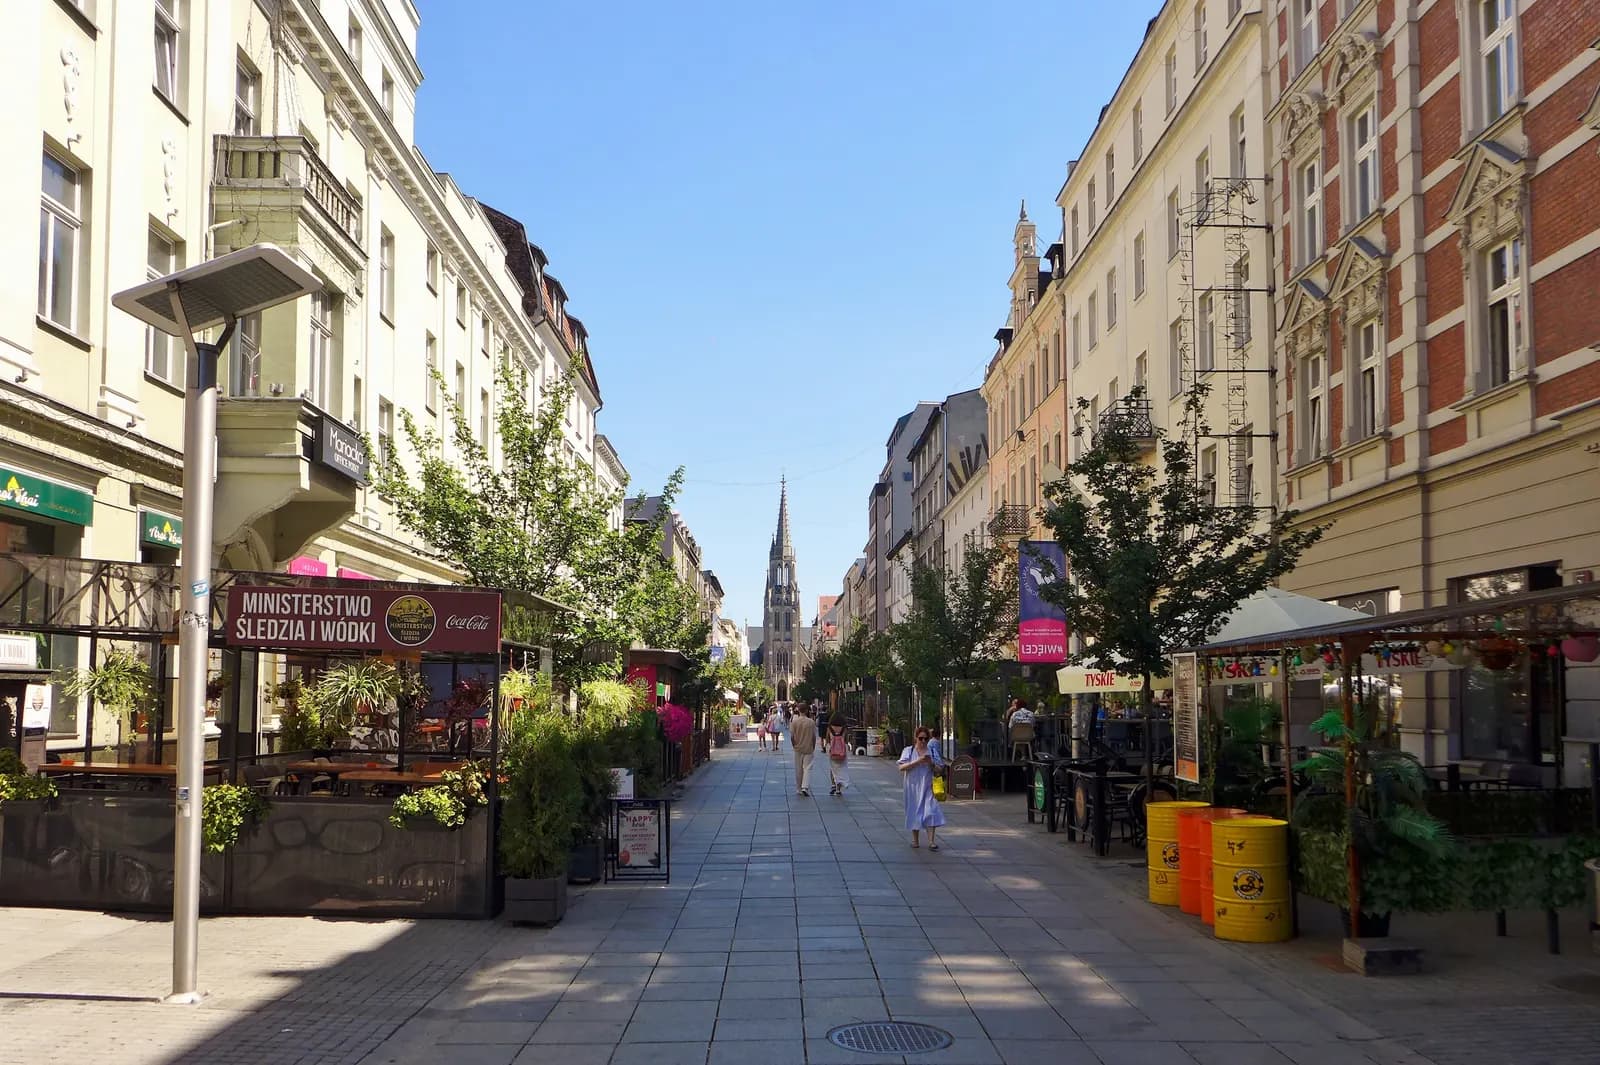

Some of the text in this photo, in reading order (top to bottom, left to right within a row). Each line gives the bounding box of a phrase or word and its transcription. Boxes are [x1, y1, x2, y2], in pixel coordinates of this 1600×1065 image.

[243, 592, 371, 617] MINISTERSTWO
[236, 614, 306, 641] ŚLEDZIA
[311, 621, 315, 640] I
[321, 617, 376, 643] WÓDKI
[1085, 672, 1115, 687] TYSKIE
[625, 815, 653, 823] HAPPY
